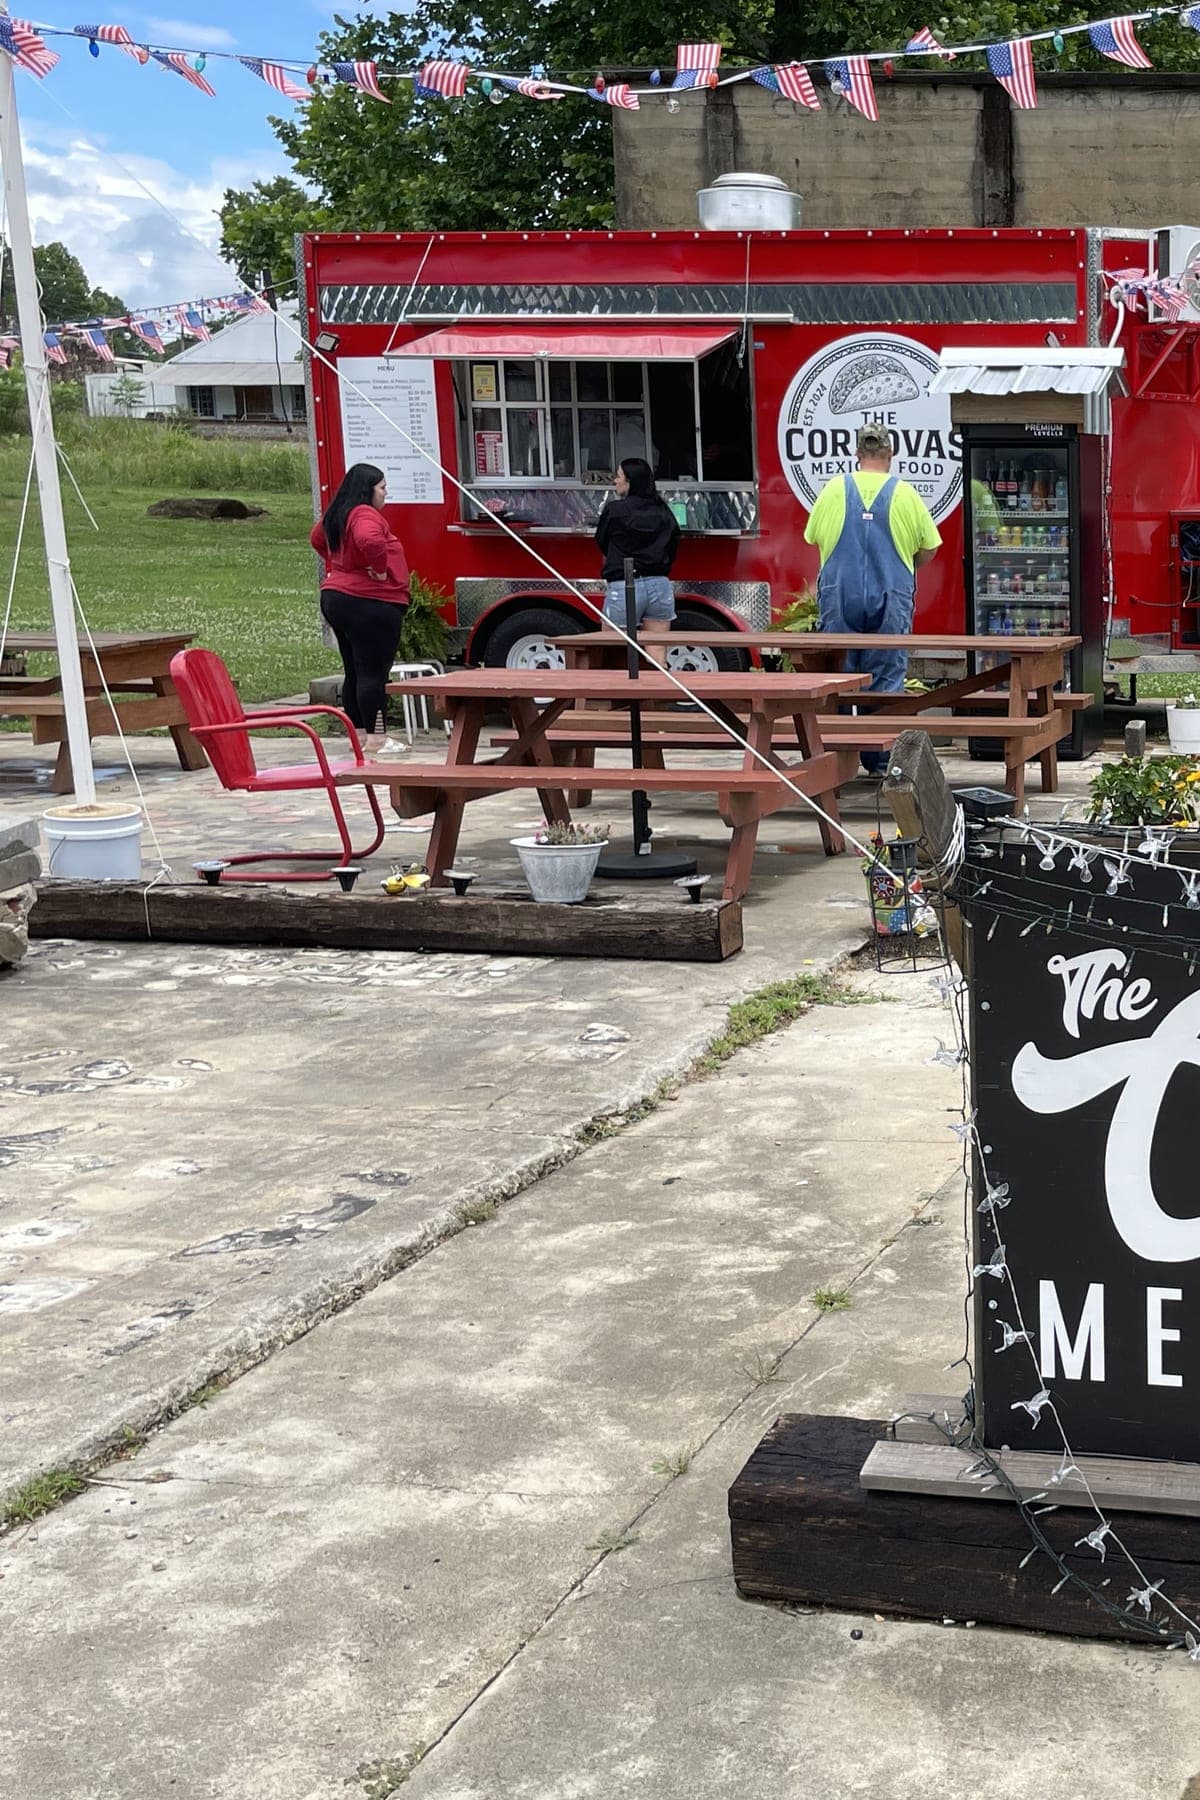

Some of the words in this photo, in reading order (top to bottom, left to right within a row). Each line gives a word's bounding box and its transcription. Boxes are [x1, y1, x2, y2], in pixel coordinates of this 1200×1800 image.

[809, 383, 828, 406] 2024
[803, 408, 816, 427] EST.
[861, 411, 897, 425] THE
[1024, 423, 1063, 431] PREMIUM
[786, 428, 963, 462] COROVAS
[898, 461, 944, 476] FOOD
[1047, 948, 1158, 1039] The
